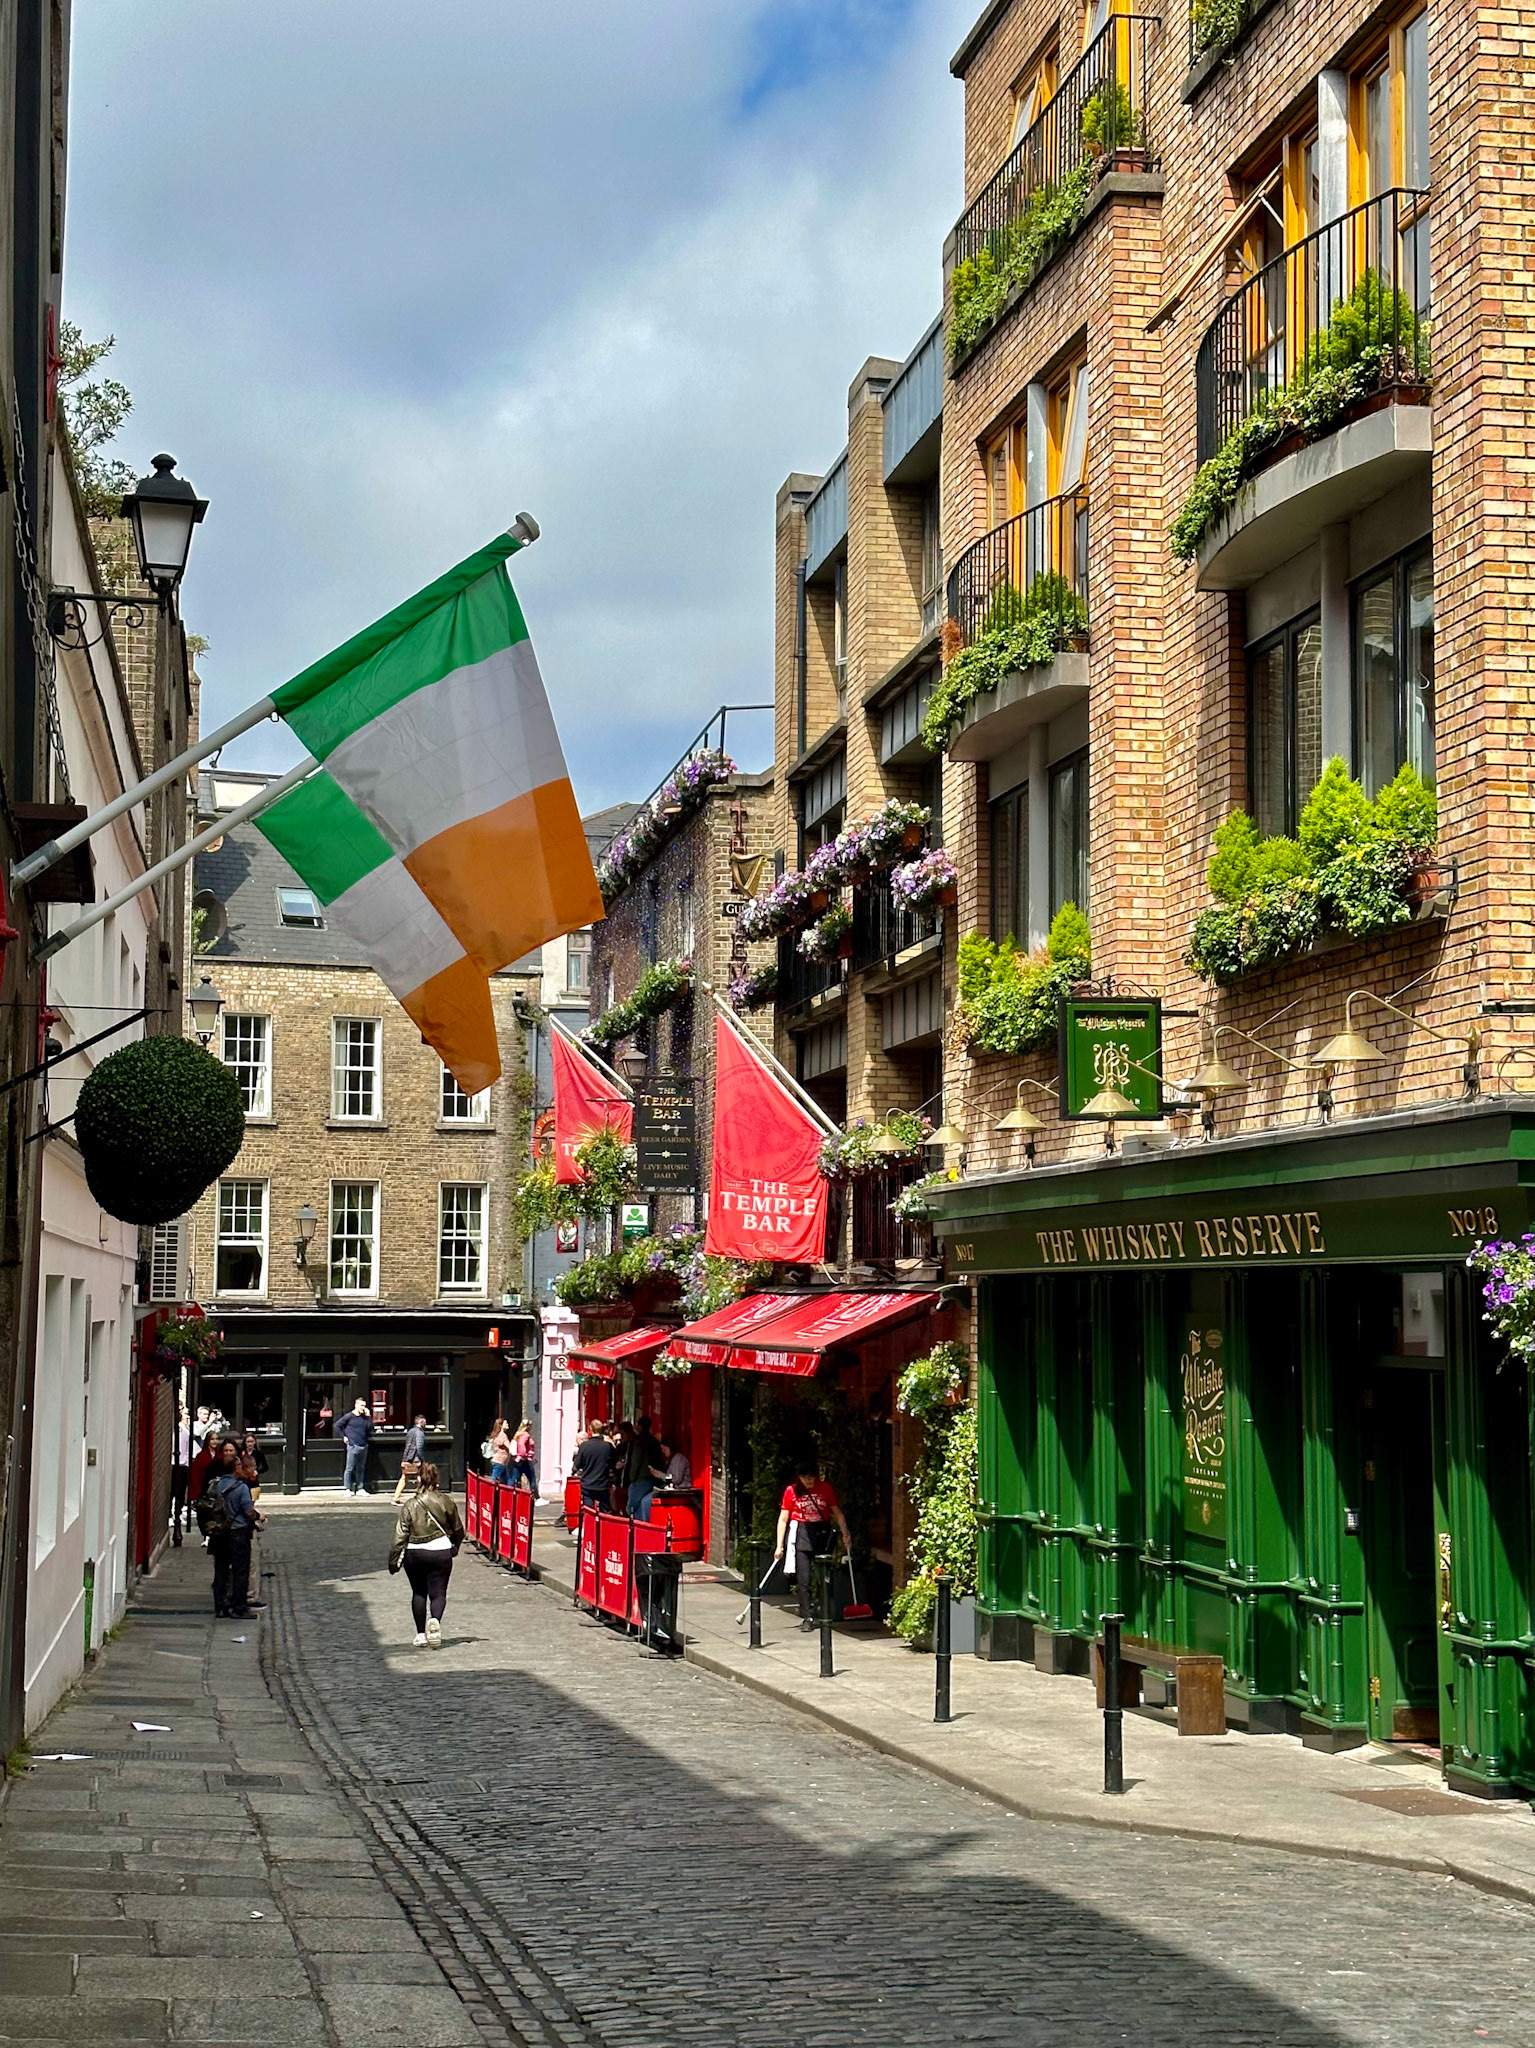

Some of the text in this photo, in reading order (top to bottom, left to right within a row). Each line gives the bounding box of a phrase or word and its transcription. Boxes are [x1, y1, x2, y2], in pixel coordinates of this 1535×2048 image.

[657, 1087, 677, 1095] THE
[640, 1095, 694, 1107] TEMPLE
[652, 1108, 682, 1120] BAR
[749, 1178, 790, 1195] THE
[720, 1191, 818, 1216] TEMPLE
[742, 1213, 793, 1233] BAR
[1036, 1212, 1326, 1264] THE WHISKEY RESERVE
